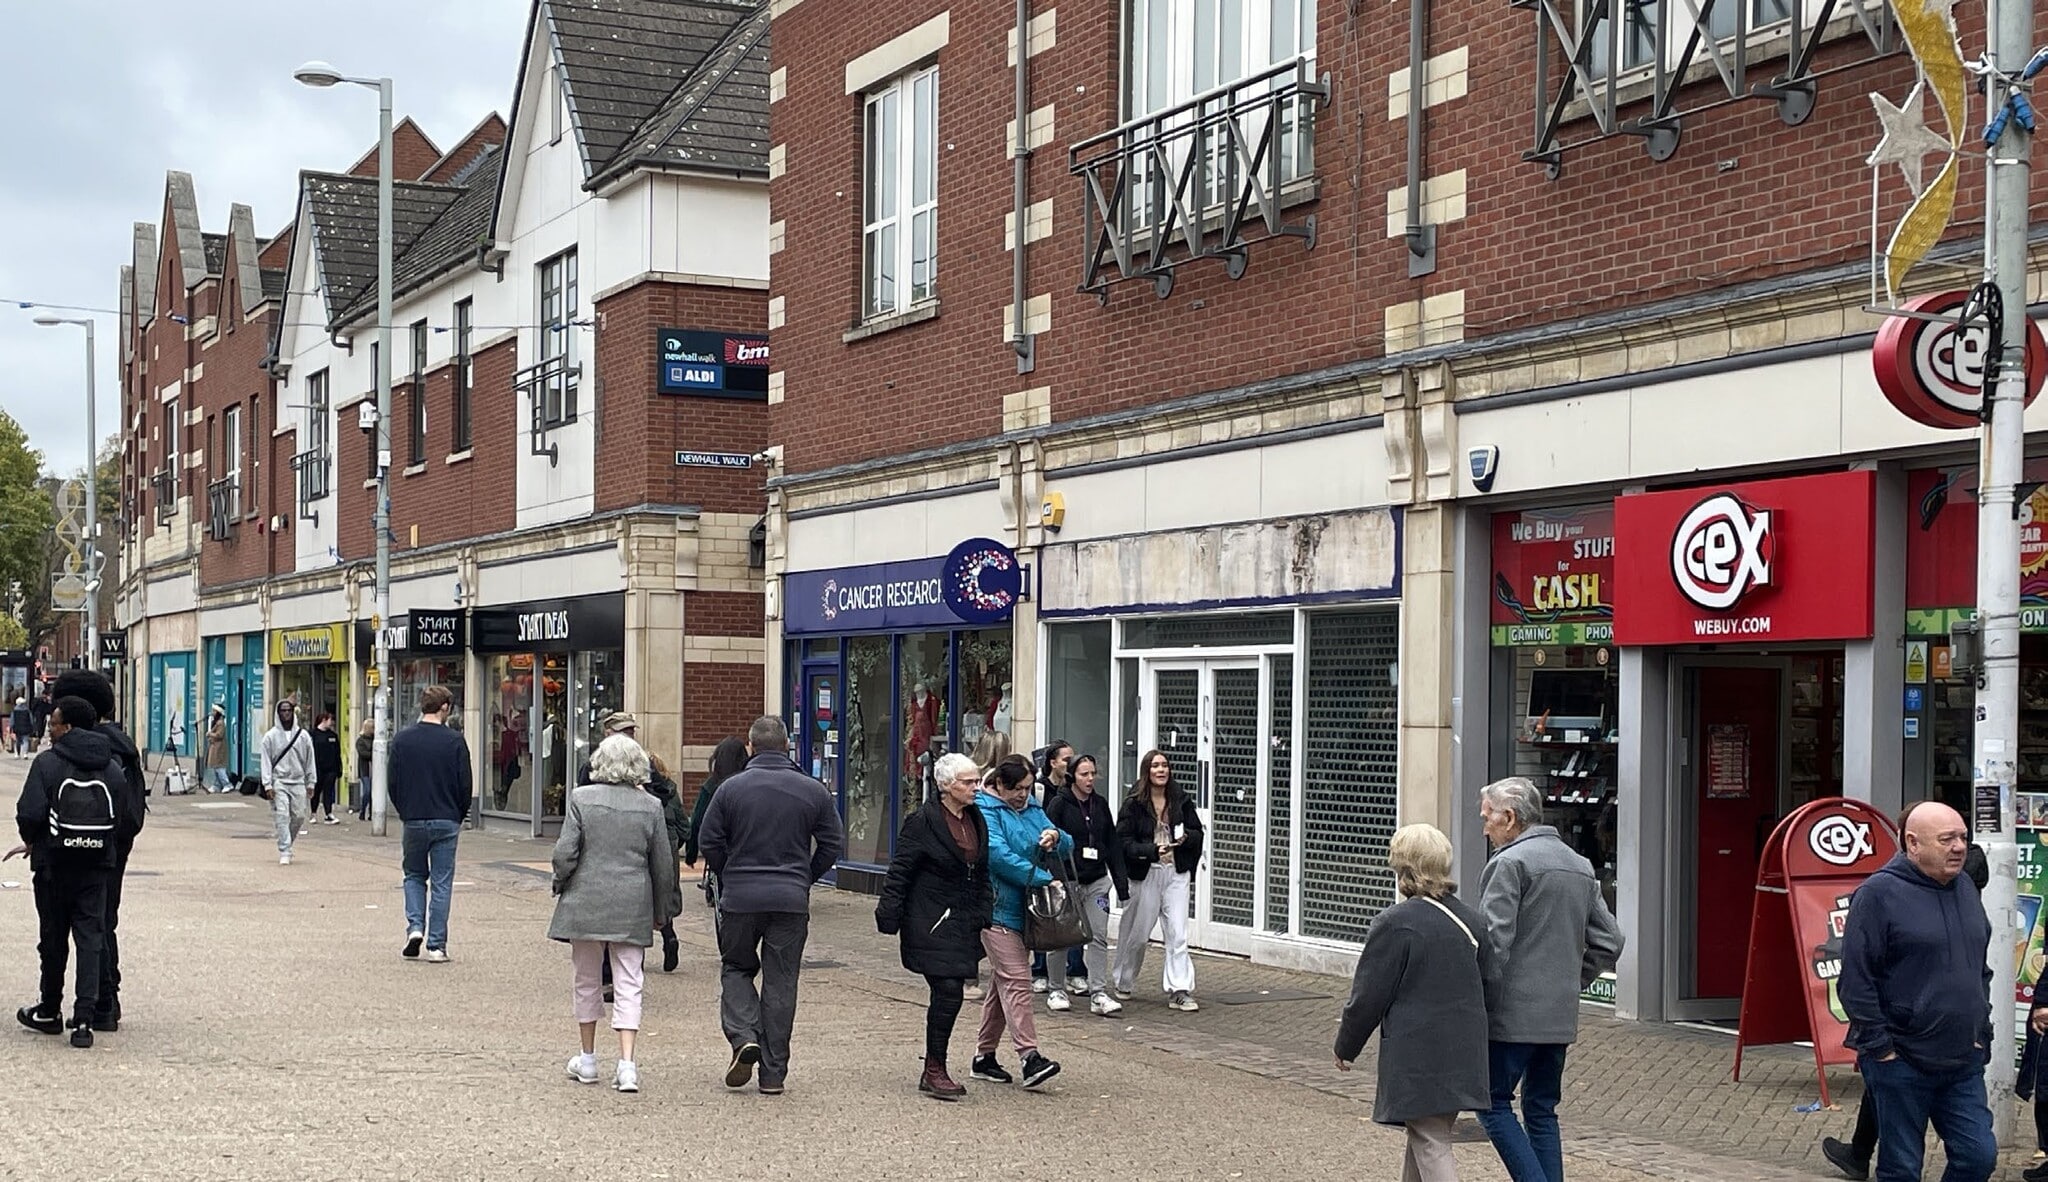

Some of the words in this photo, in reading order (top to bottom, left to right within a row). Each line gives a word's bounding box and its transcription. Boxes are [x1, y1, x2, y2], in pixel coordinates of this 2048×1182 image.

[664, 352, 698, 363] newhall
[698, 354, 717, 364] walk
[684, 369, 715, 383] ALDI
[680, 453, 720, 466] NEWHALL
[722, 455, 746, 466] WALK
[1511, 522, 1533, 541] We
[1535, 520, 1563, 541] Buy
[1565, 525, 1584, 538] your
[1558, 560, 1570, 572] for
[838, 584, 884, 612] CANCER
[1533, 573, 1599, 611] CASH
[417, 616, 458, 631] SMART
[518, 612, 545, 642] SMART
[545, 610, 569, 640] IDEAS
[1694, 616, 1771, 635] WEBUY.COM
[419, 632, 455, 646] IDEAS
[1511, 627, 1552, 642] GAMING
[104, 638, 121, 651] W
[63, 836, 104, 849] adidas
